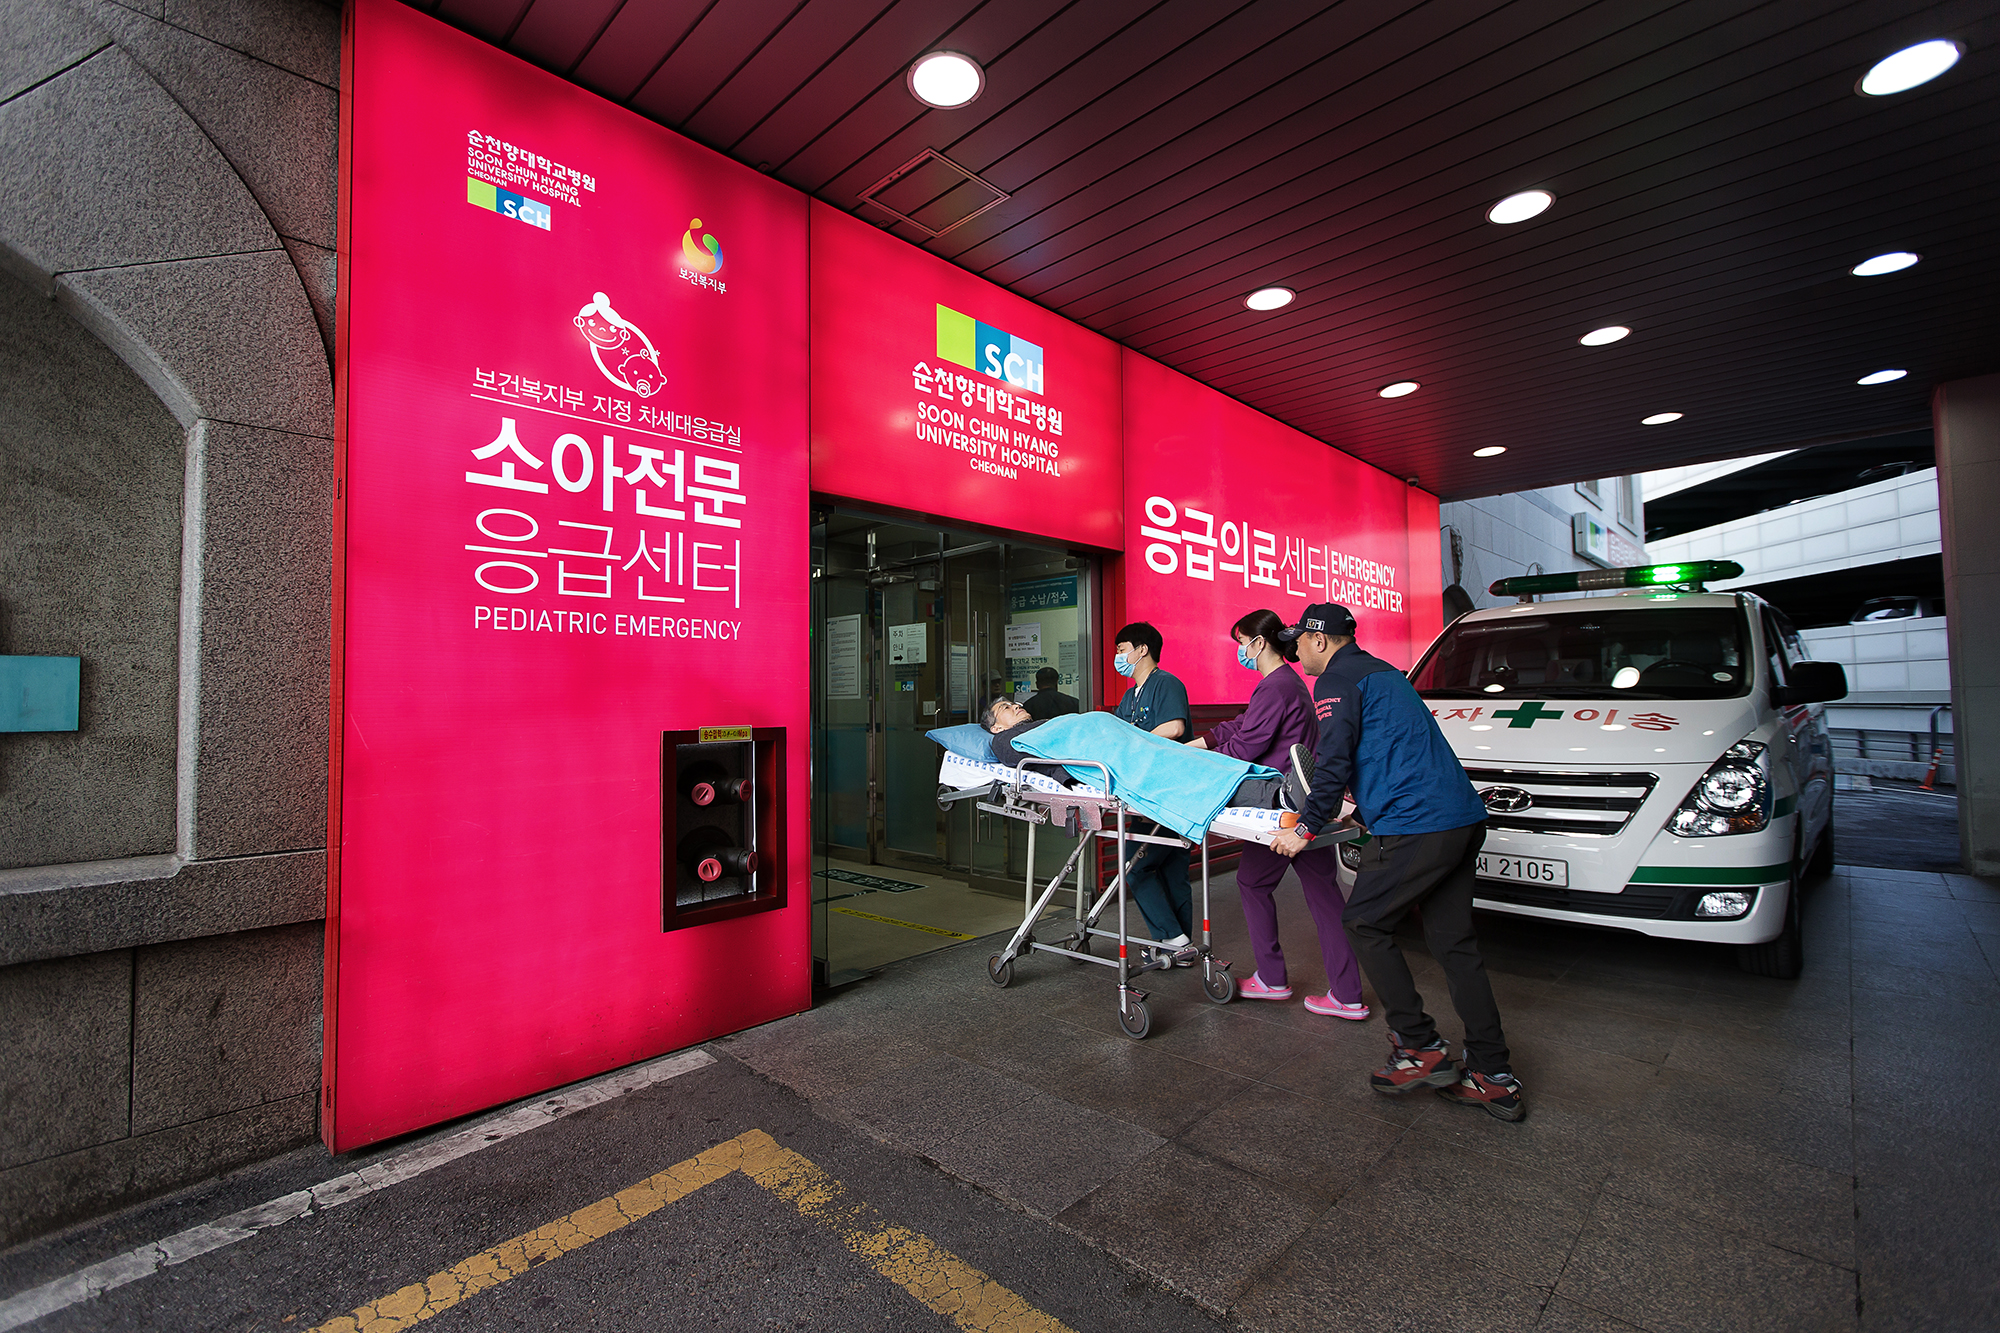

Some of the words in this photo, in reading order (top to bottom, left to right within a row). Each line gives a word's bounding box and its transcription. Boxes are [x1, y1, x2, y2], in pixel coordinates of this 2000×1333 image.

[467, 129, 596, 193] 순천향대학교병원
[467, 147, 503, 168] SOON
[506, 162, 538, 181] CHUN
[541, 174, 579, 196] HYANG
[467, 167, 508, 187] CHEONAN
[468, 156, 529, 187] UNIVERSITY
[532, 181, 582, 207] HOSPITAL
[503, 199, 551, 231] SCH
[678, 267, 728, 295] 보건복지부
[984, 343, 1044, 396] SCH
[473, 367, 586, 411] 보건복지부
[592, 395, 632, 423] 지정
[638, 404, 742, 447] 차세대응급실
[912, 361, 1063, 436] 순천향대학교병원
[917, 401, 965, 431] SOON
[969, 417, 1009, 444] CHUN
[1013, 430, 1059, 458] HYANG
[916, 421, 997, 459] UNIVERSITY
[1001, 446, 1061, 478] HOSPITAL
[969, 457, 1018, 480] CHEONAN
[465, 416, 747, 529] 소아전문
[464, 508, 741, 609] 응급센터
[1331, 550, 1396, 588] EMERGENCY
[1011, 596, 1026, 609] 응급
[1029, 591, 1069, 606] 수납/접수
[1331, 578, 1362, 606] CARE
[1363, 586, 1404, 613] CENTER
[474, 605, 608, 635] PEDIATRIC
[615, 614, 742, 641] EMERGENCY
[1015, 684, 1031, 693] SCH
[1573, 709, 1680, 732] 이송
[1499, 858, 1554, 881] 2105
